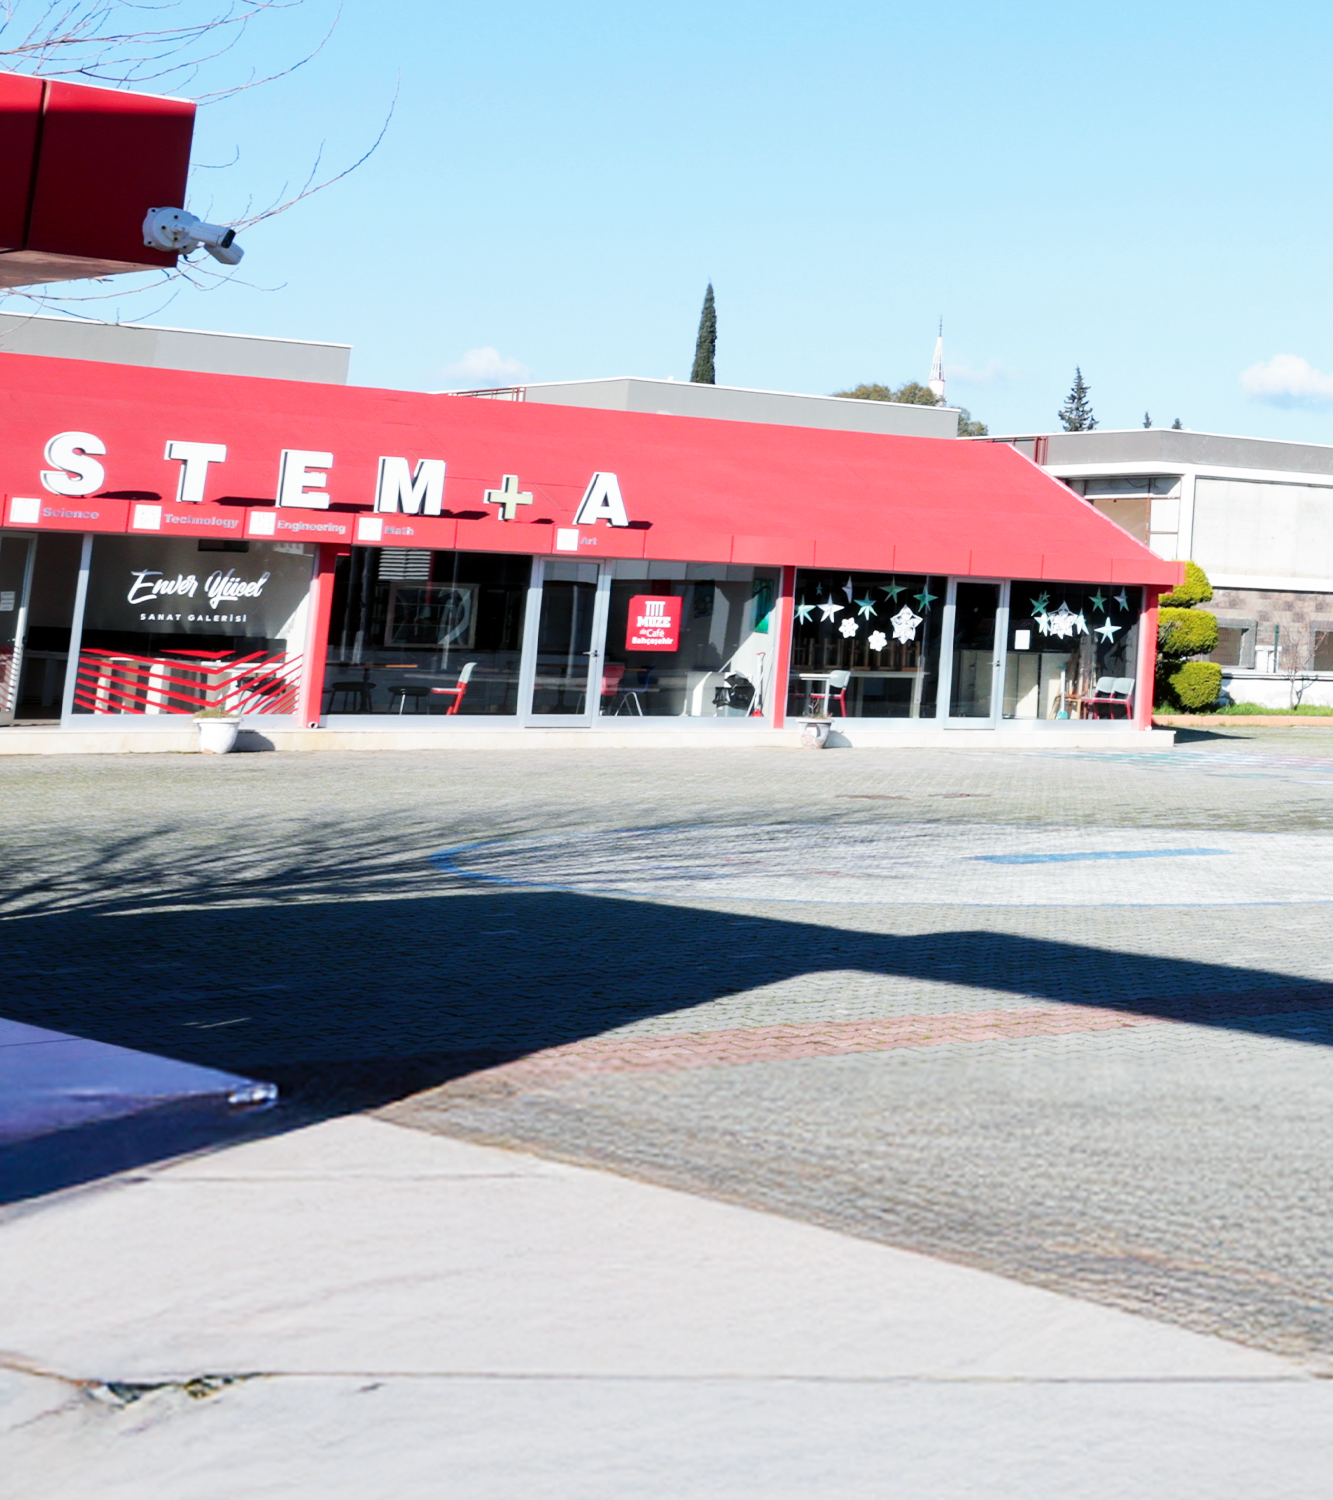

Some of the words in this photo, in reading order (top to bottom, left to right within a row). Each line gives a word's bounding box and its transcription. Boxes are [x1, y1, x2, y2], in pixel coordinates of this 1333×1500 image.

[42, 507, 100, 520] Science
[164, 513, 240, 529] Technology
[277, 519, 347, 535] Engineering
[384, 525, 415, 536] Math
[580, 536, 598, 546] Art
[127, 569, 199, 605] Enver
[203, 568, 271, 610] Yücel
[139, 613, 182, 622] SANAT
[187, 613, 248, 623] GALERİSİ
